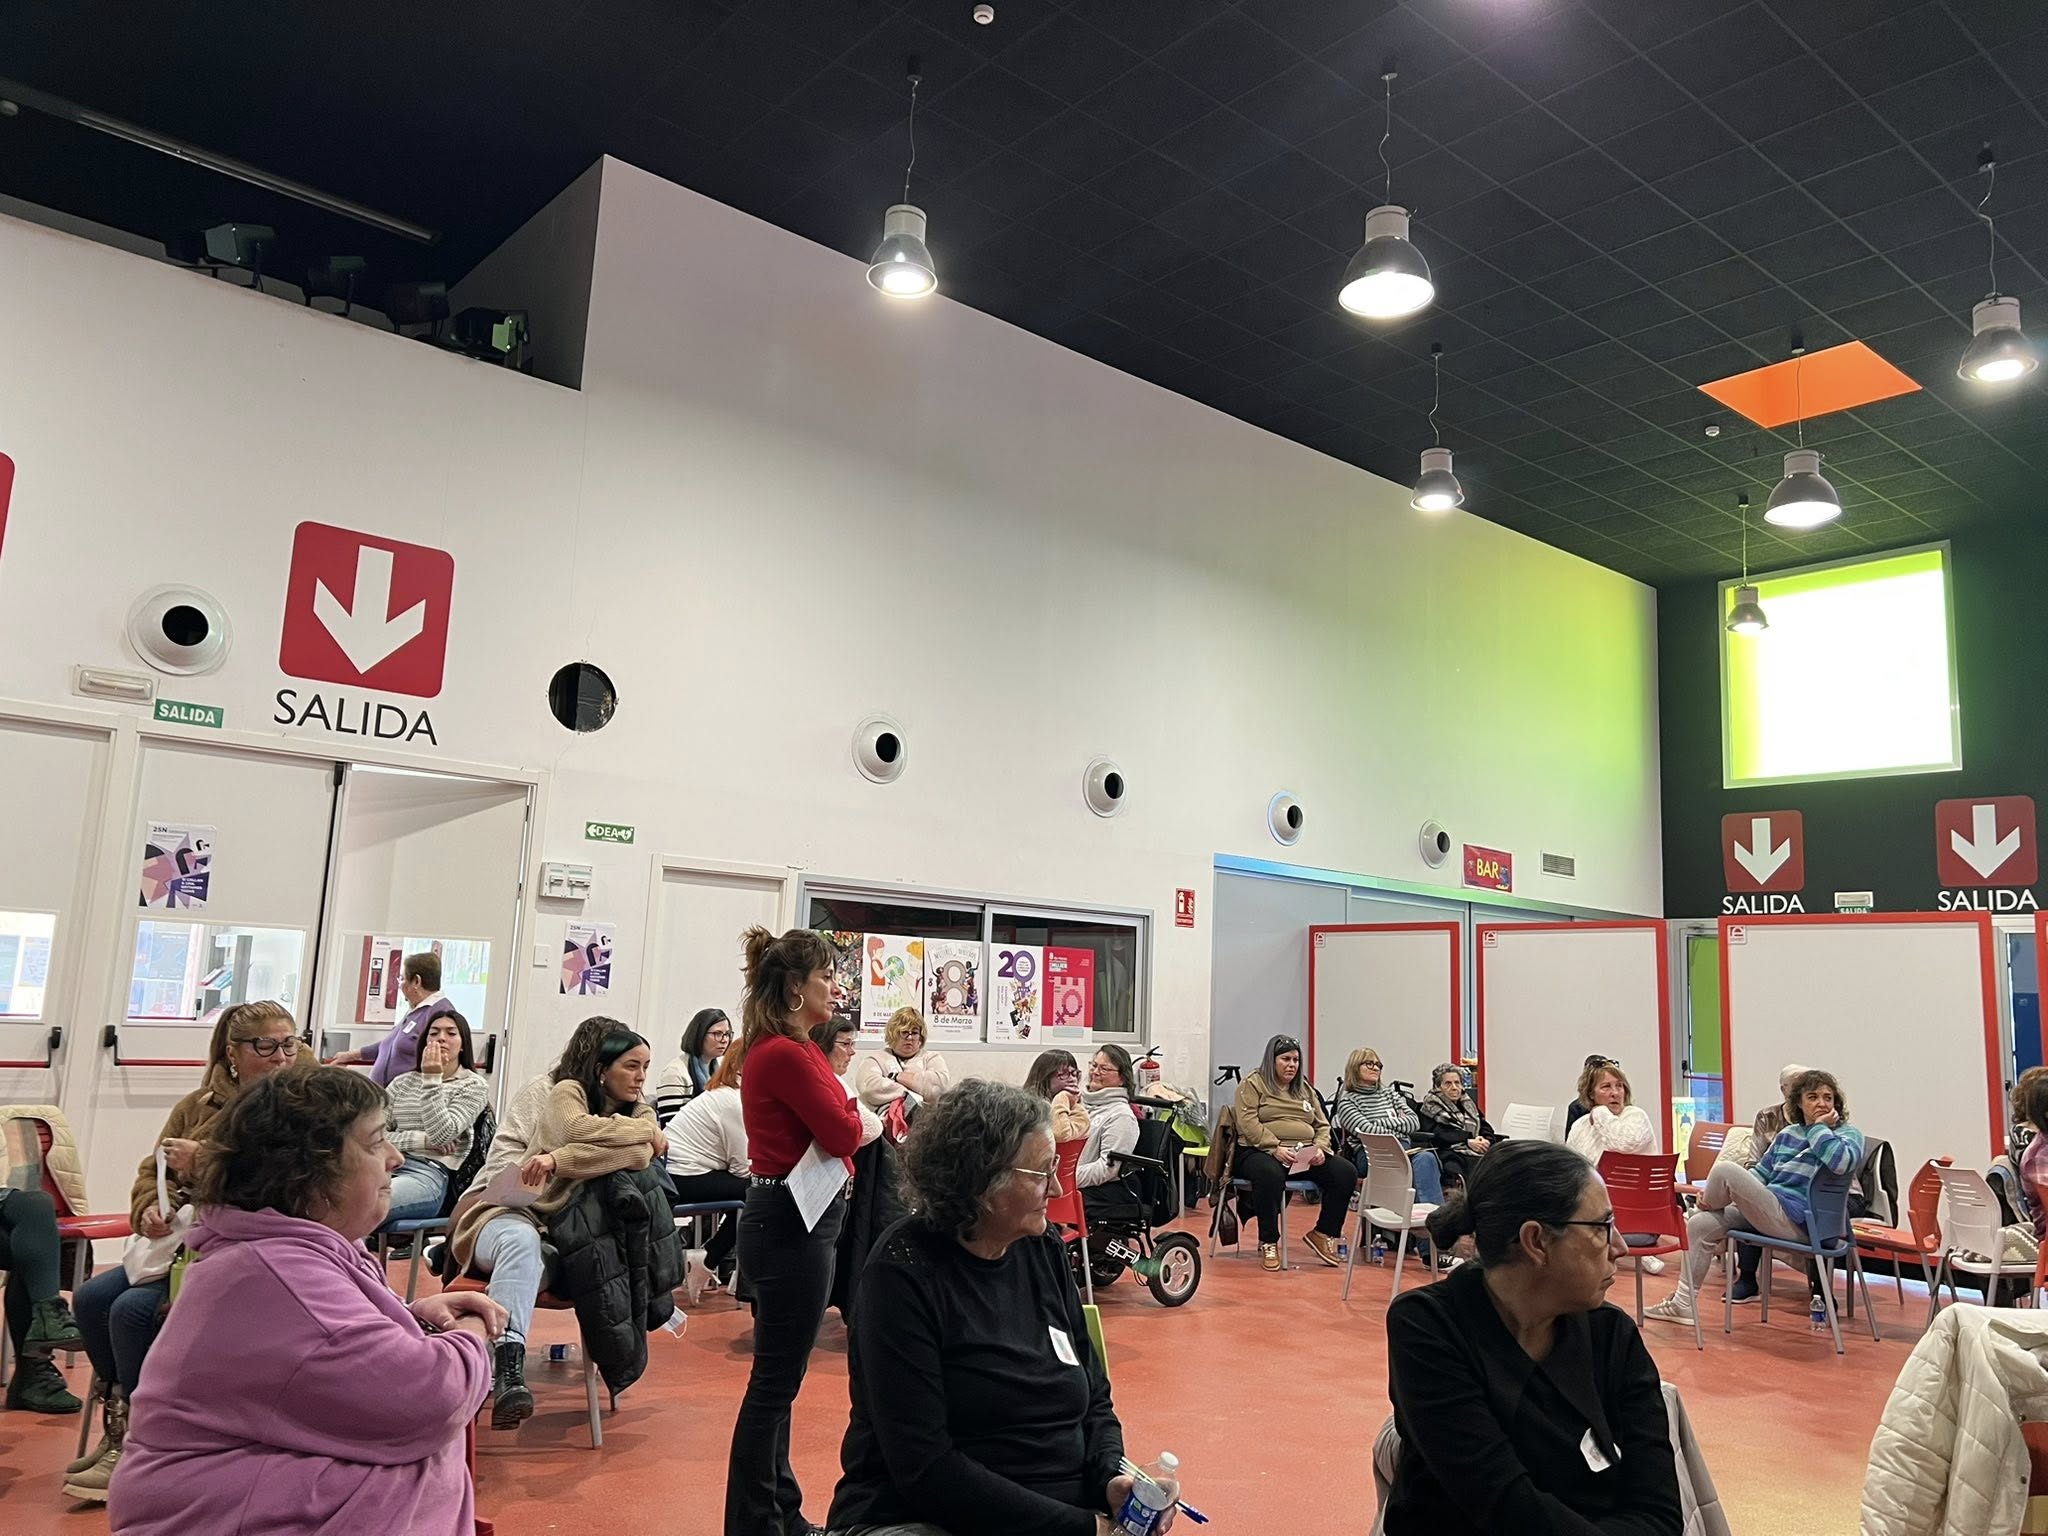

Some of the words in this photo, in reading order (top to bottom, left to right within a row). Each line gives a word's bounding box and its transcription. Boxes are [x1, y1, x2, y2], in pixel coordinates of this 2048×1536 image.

[158, 703, 216, 725] SALIDA
[274, 689, 438, 746] SALIDA
[596, 826, 618, 838] DEA
[1476, 858, 1500, 880] BAR
[1722, 894, 1805, 914] SALIDA
[1937, 889, 2039, 911] SALIDA
[998, 950, 1036, 983] 20
[934, 1014, 939, 1024] 8
[940, 1015, 950, 1024] de
[950, 1016, 973, 1025] Marzo
